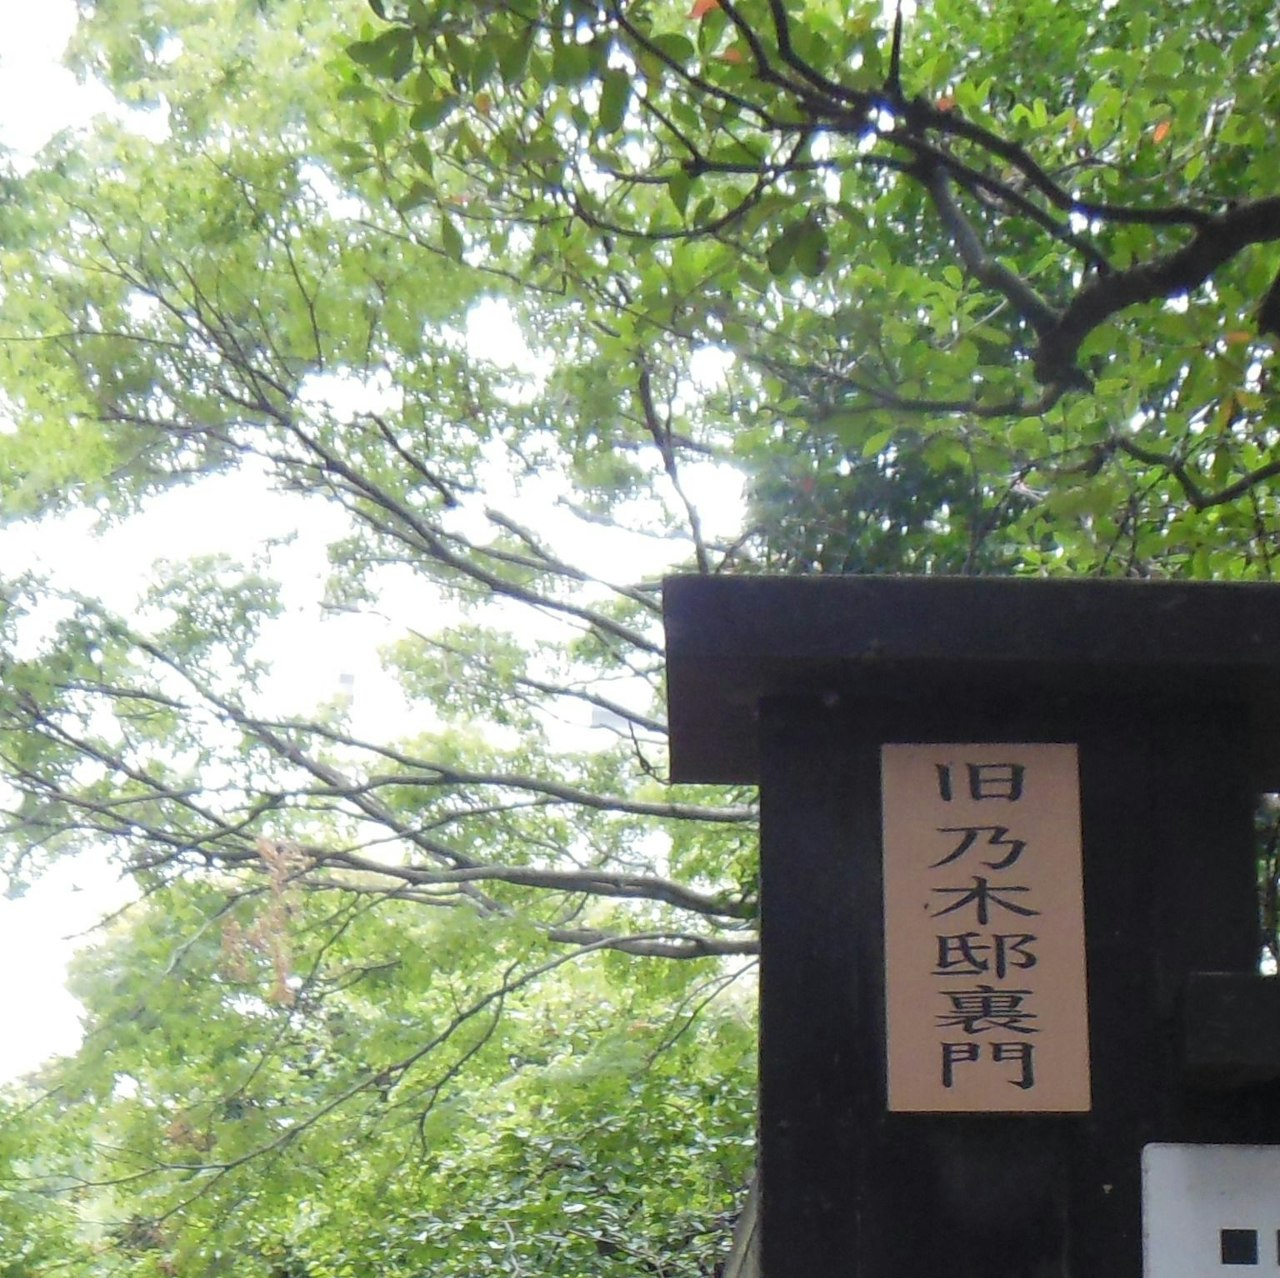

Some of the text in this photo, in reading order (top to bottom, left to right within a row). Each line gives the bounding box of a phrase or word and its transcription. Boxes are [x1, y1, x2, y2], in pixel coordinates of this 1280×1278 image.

[928, 762, 1042, 1091] 旧乃木邸裏門
